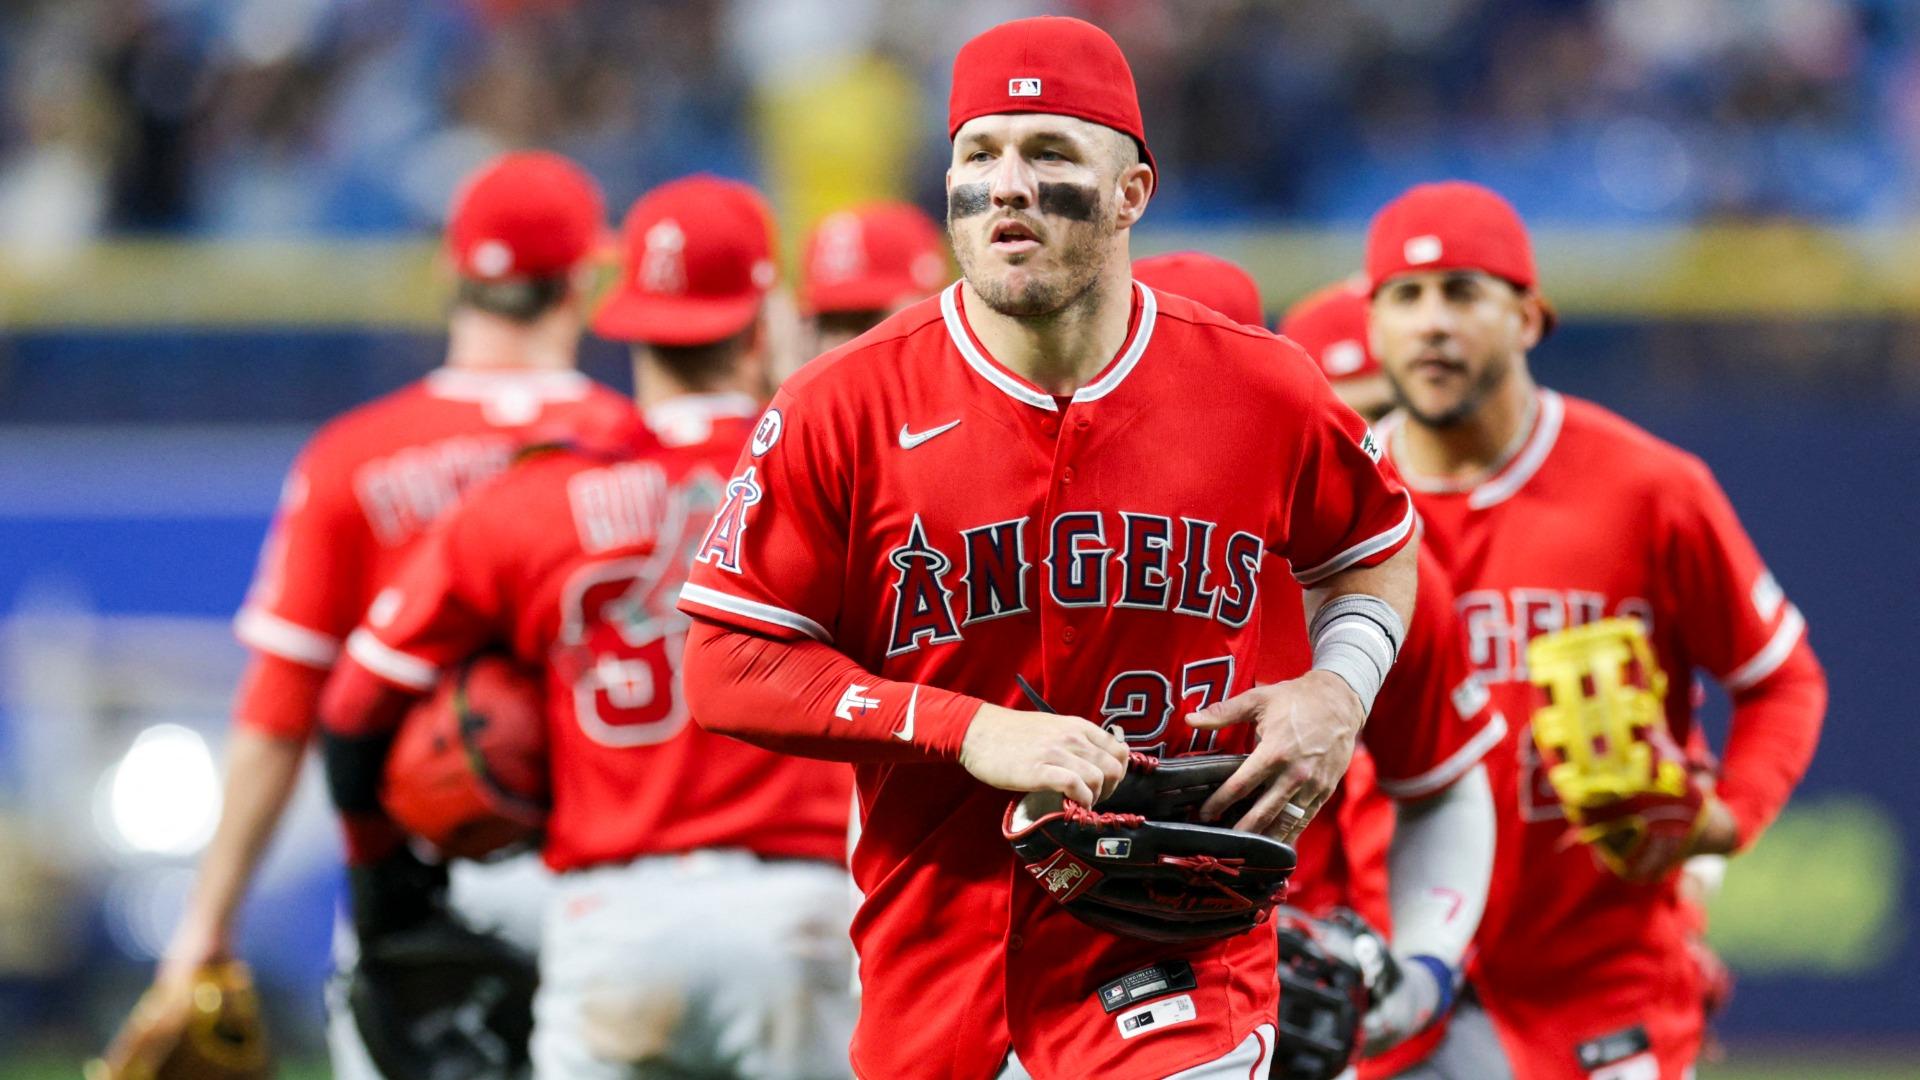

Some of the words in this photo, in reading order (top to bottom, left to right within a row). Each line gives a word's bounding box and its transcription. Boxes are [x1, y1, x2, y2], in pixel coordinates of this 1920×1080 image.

[695, 466, 762, 574] A
[886, 512, 1264, 657] ANGELS
[1100, 654, 1235, 757] 27
